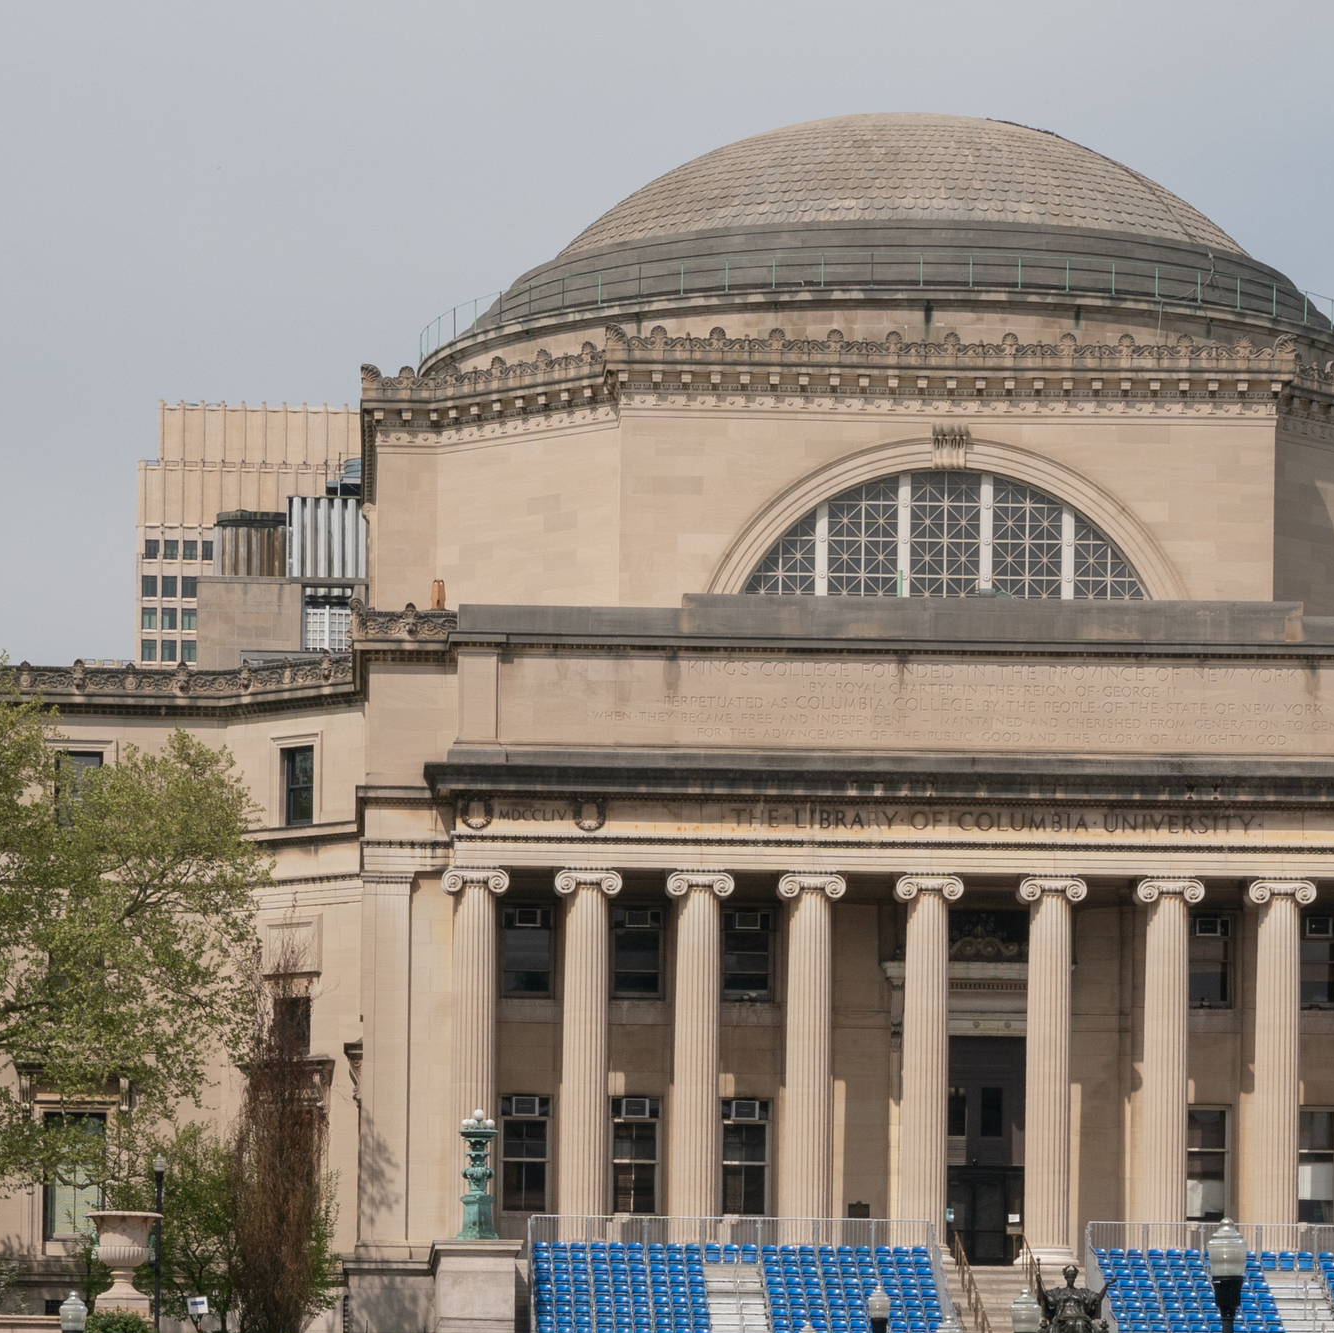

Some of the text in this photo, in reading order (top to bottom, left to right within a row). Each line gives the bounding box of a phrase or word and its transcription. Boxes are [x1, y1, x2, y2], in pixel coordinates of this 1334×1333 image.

[760, 662, 850, 678] COLLEGE
[862, 663, 954, 679] FOUNDED
[967, 665, 986, 679] IN
[997, 665, 1037, 680] THE
[1048, 666, 1145, 682] PROVINCE
[1155, 667, 1181, 682] OF
[1192, 668, 1234, 683] NEW
[1247, 668, 1303, 683] YORK
[809, 682, 827, 693] BY
[836, 682, 881, 693] ROYAL
[889, 682, 954, 695] CHARTER
[963, 684, 978, 694] IN
[986, 684, 1014, 696] THE
[1024, 685, 1066, 697] REIGN
[1075, 685, 1095, 697] OF
[1102, 686, 1160, 698] GEORGE
[663, 696, 1325, 716] PERPETUATED AS COLUMBIA COLLEGE BY THE PEOPLE OF THE STATE OF NEW YORK
[592, 711, 632, 722] WHEN
[639, 711, 674, 722] THEY
[681, 712, 733, 723] BECAME
[741, 713, 772, 724] FREE
[780, 714, 808, 725] AND
[817, 714, 910, 726] INDEPENDENT
[940, 716, 1023, 727] MAINTAINED
[1031, 717, 1058, 728] AND
[1067, 717, 1141, 729] CHERISHED
[1149, 718, 1185, 729] FROM
[1193, 719, 1280, 730] GENERATION
[1286, 720, 1303, 731] TO
[697, 727, 1287, 745] FOR THE ADVANCEMENT OF THE PUBLIC GOOD AND THE GLORY OF ALMIGHTY GOD
[498, 808, 567, 822] MDCCLIV
[731, 808, 1256, 835] THE LIBRARY OF COLUMBIA UNIVERSITY
